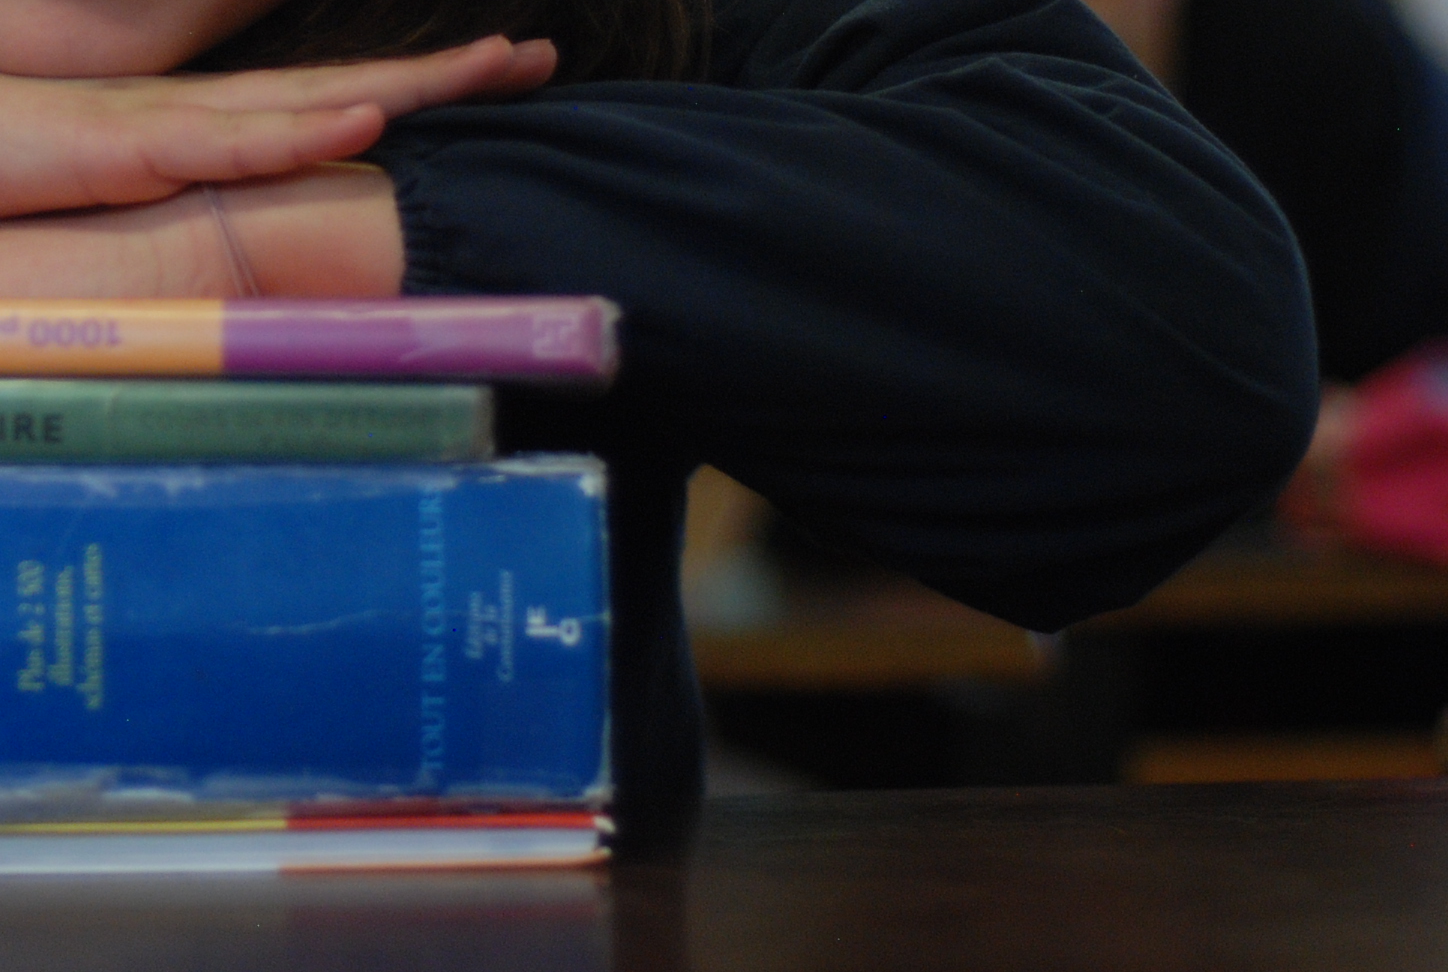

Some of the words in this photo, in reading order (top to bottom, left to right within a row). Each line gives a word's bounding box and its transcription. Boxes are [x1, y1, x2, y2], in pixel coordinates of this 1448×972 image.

[28, 318, 123, 348] 1000
[420, 643, 446, 684] EN
[420, 694, 445, 773] TOUT
